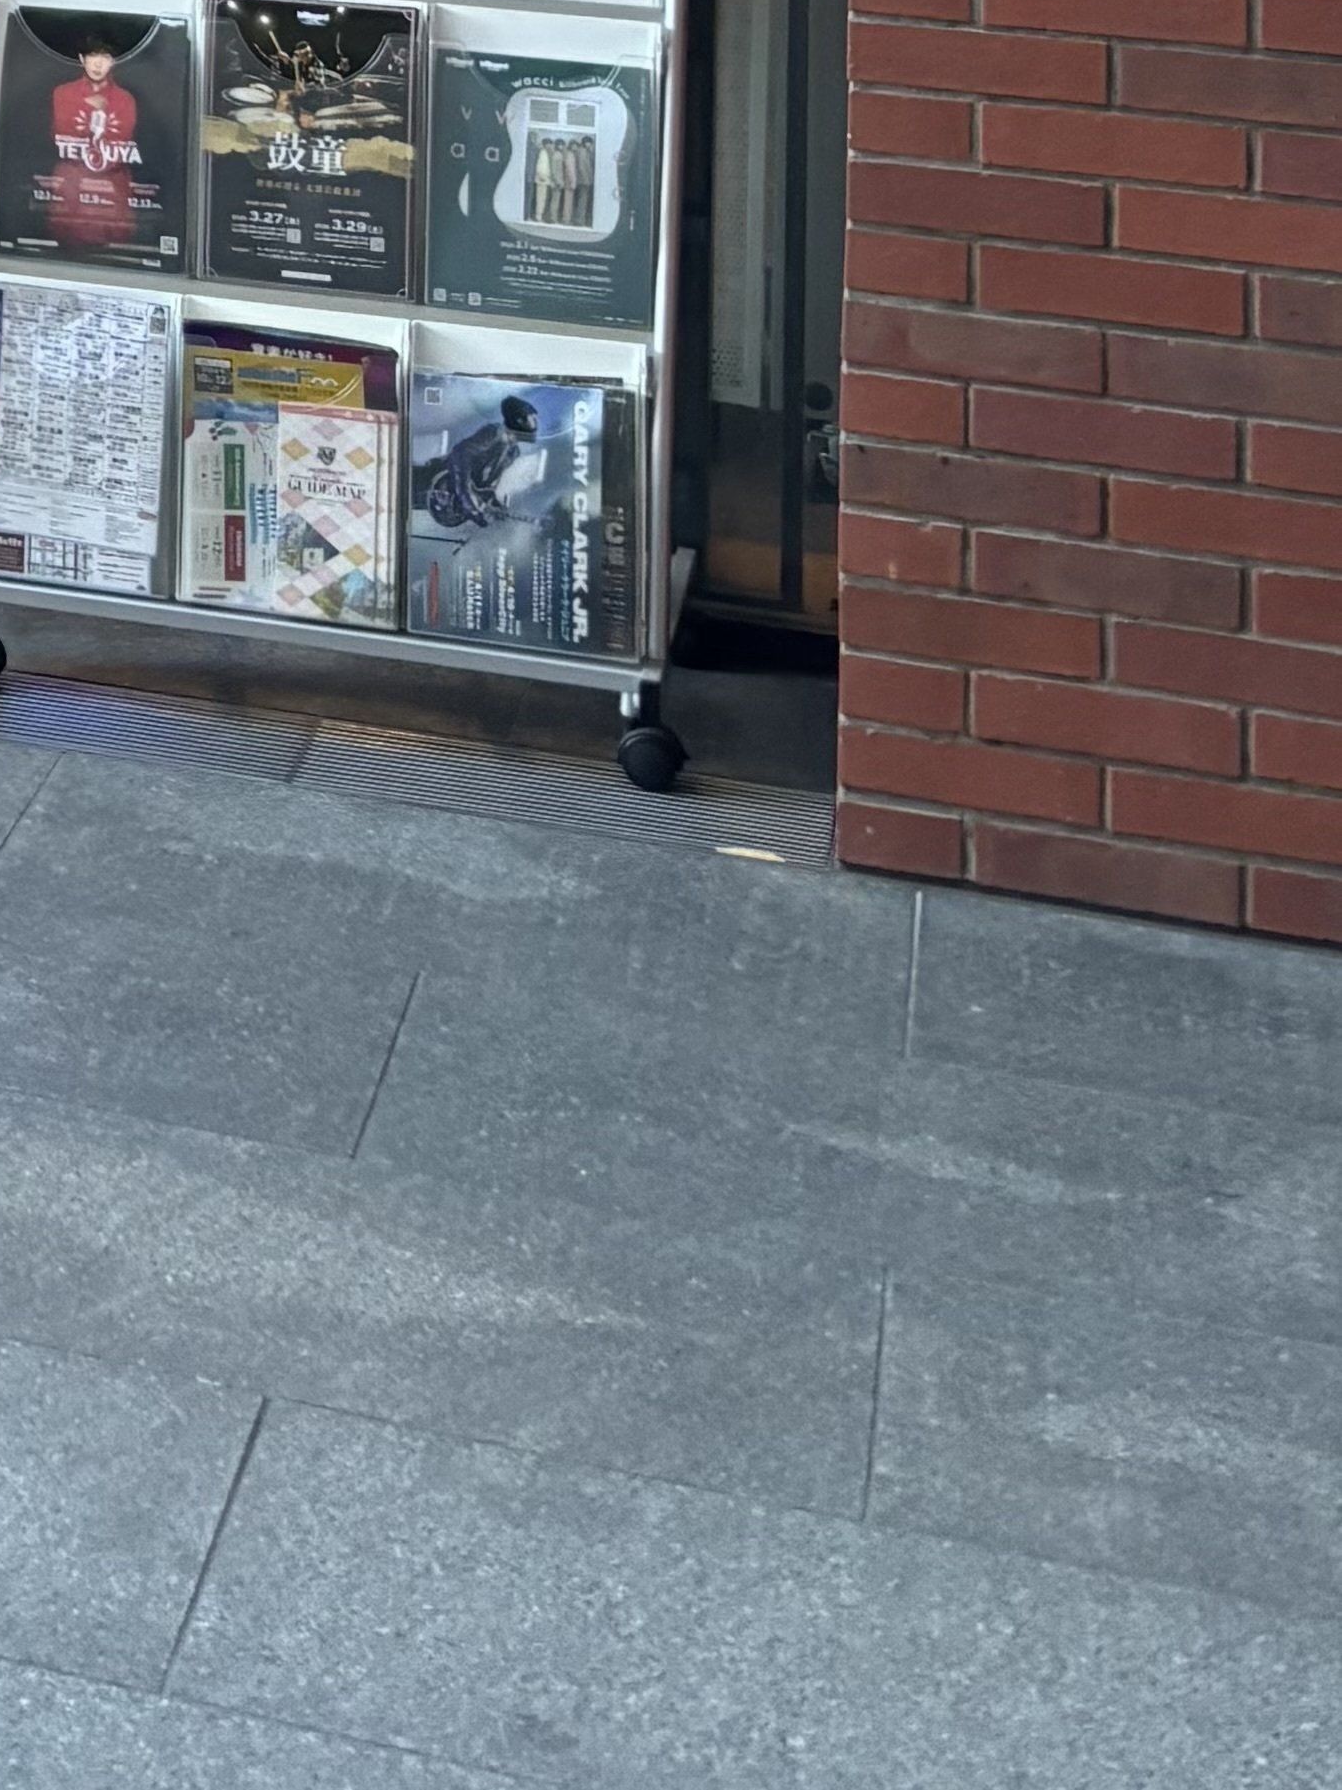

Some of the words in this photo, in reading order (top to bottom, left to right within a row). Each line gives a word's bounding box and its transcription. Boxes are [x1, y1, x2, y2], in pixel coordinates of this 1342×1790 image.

[572, 400, 591, 487] GARY
[571, 492, 590, 594] CLARK
[571, 596, 590, 644] JR.
